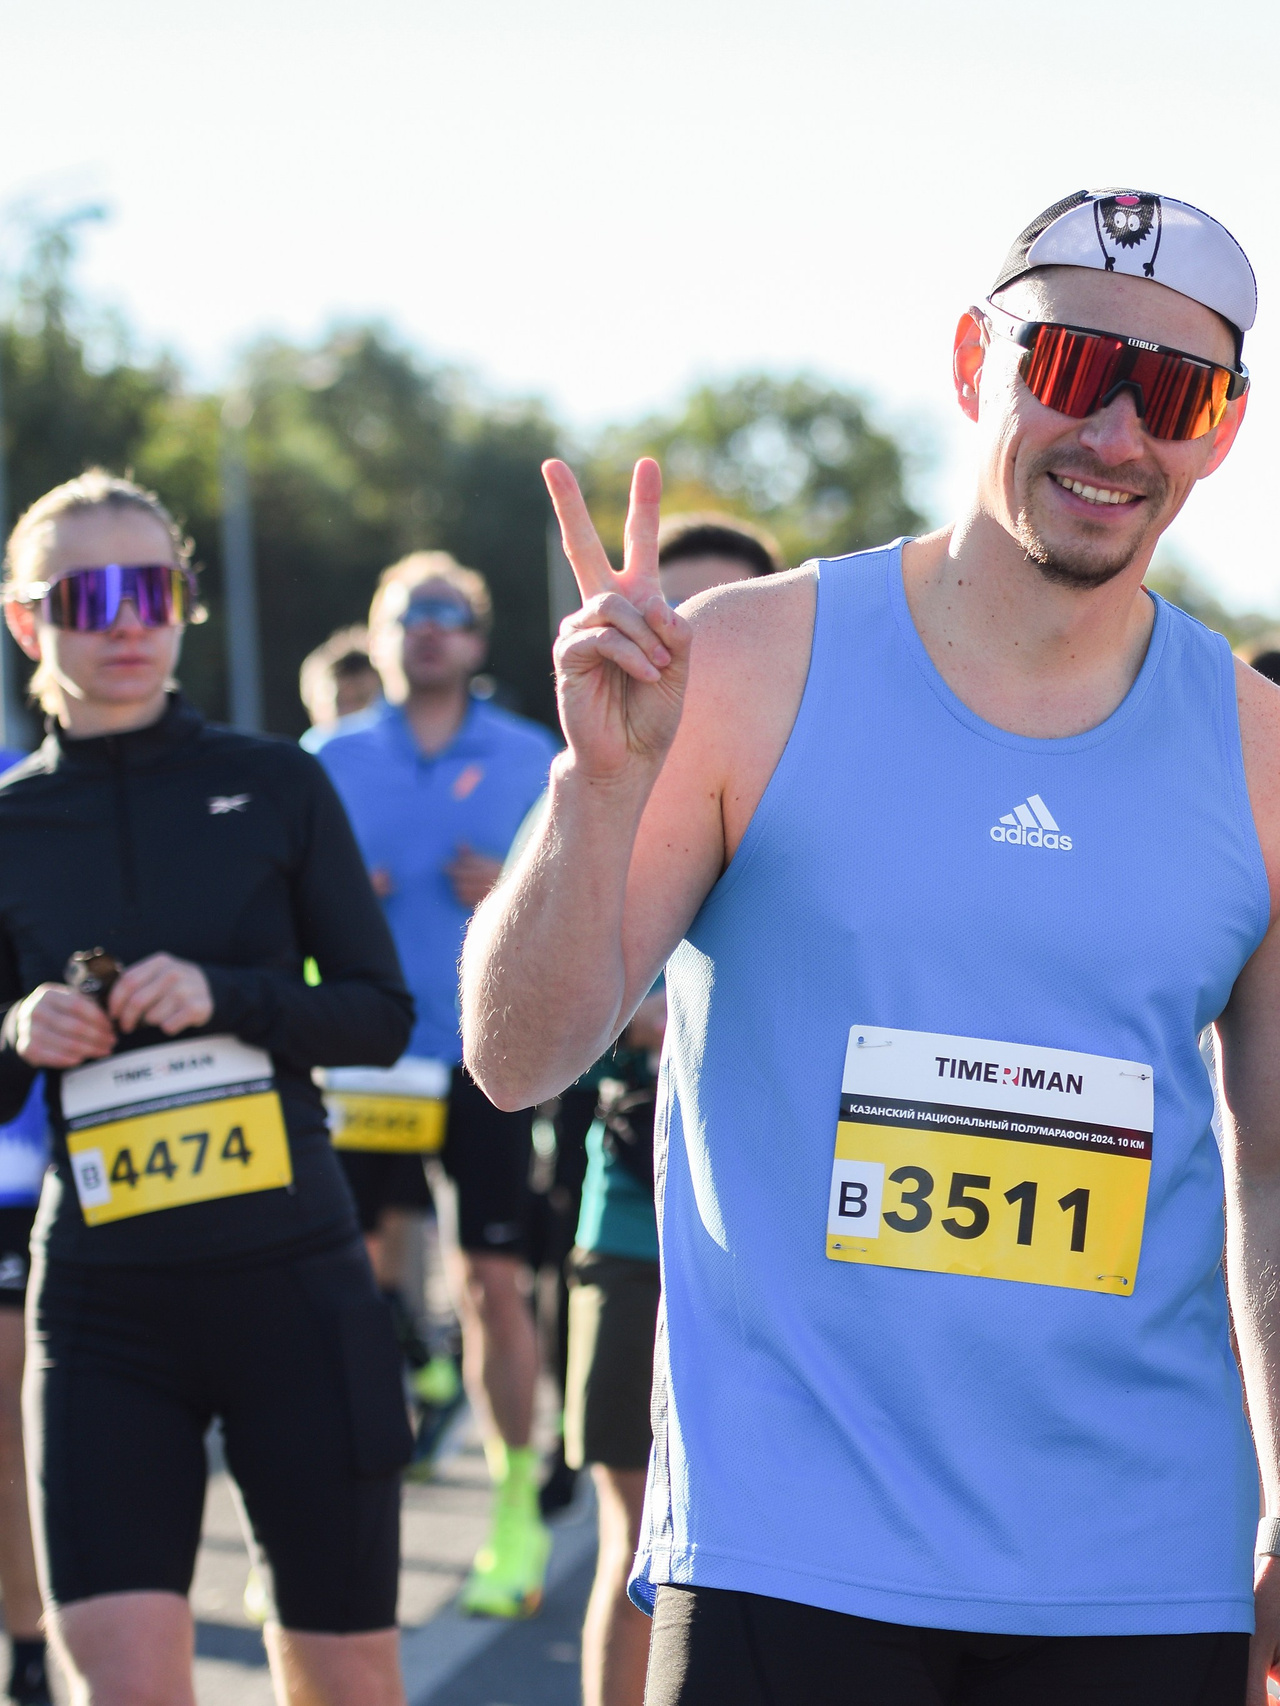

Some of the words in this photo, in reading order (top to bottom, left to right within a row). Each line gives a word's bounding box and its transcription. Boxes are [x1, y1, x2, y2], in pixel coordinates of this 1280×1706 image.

[990, 825, 1073, 851] adidas
[113, 1055, 214, 1085] TIMEMAN
[849, 1104, 916, 1119] КАЗАНСКИЙ
[917, 1111, 1009, 1130] НАЦИОНАЛЬНЫЙ
[1010, 1122, 1090, 1142] ПОЛУМАРАФОН
[1090, 1133, 1116, 1146] 2024.
[1117, 1138, 1129, 1147] 10
[1130, 1140, 1145, 1150] КМ
[110, 1125, 253, 1190] 4474
[838, 1181, 868, 1218] B
[882, 1165, 1091, 1253] 3511
